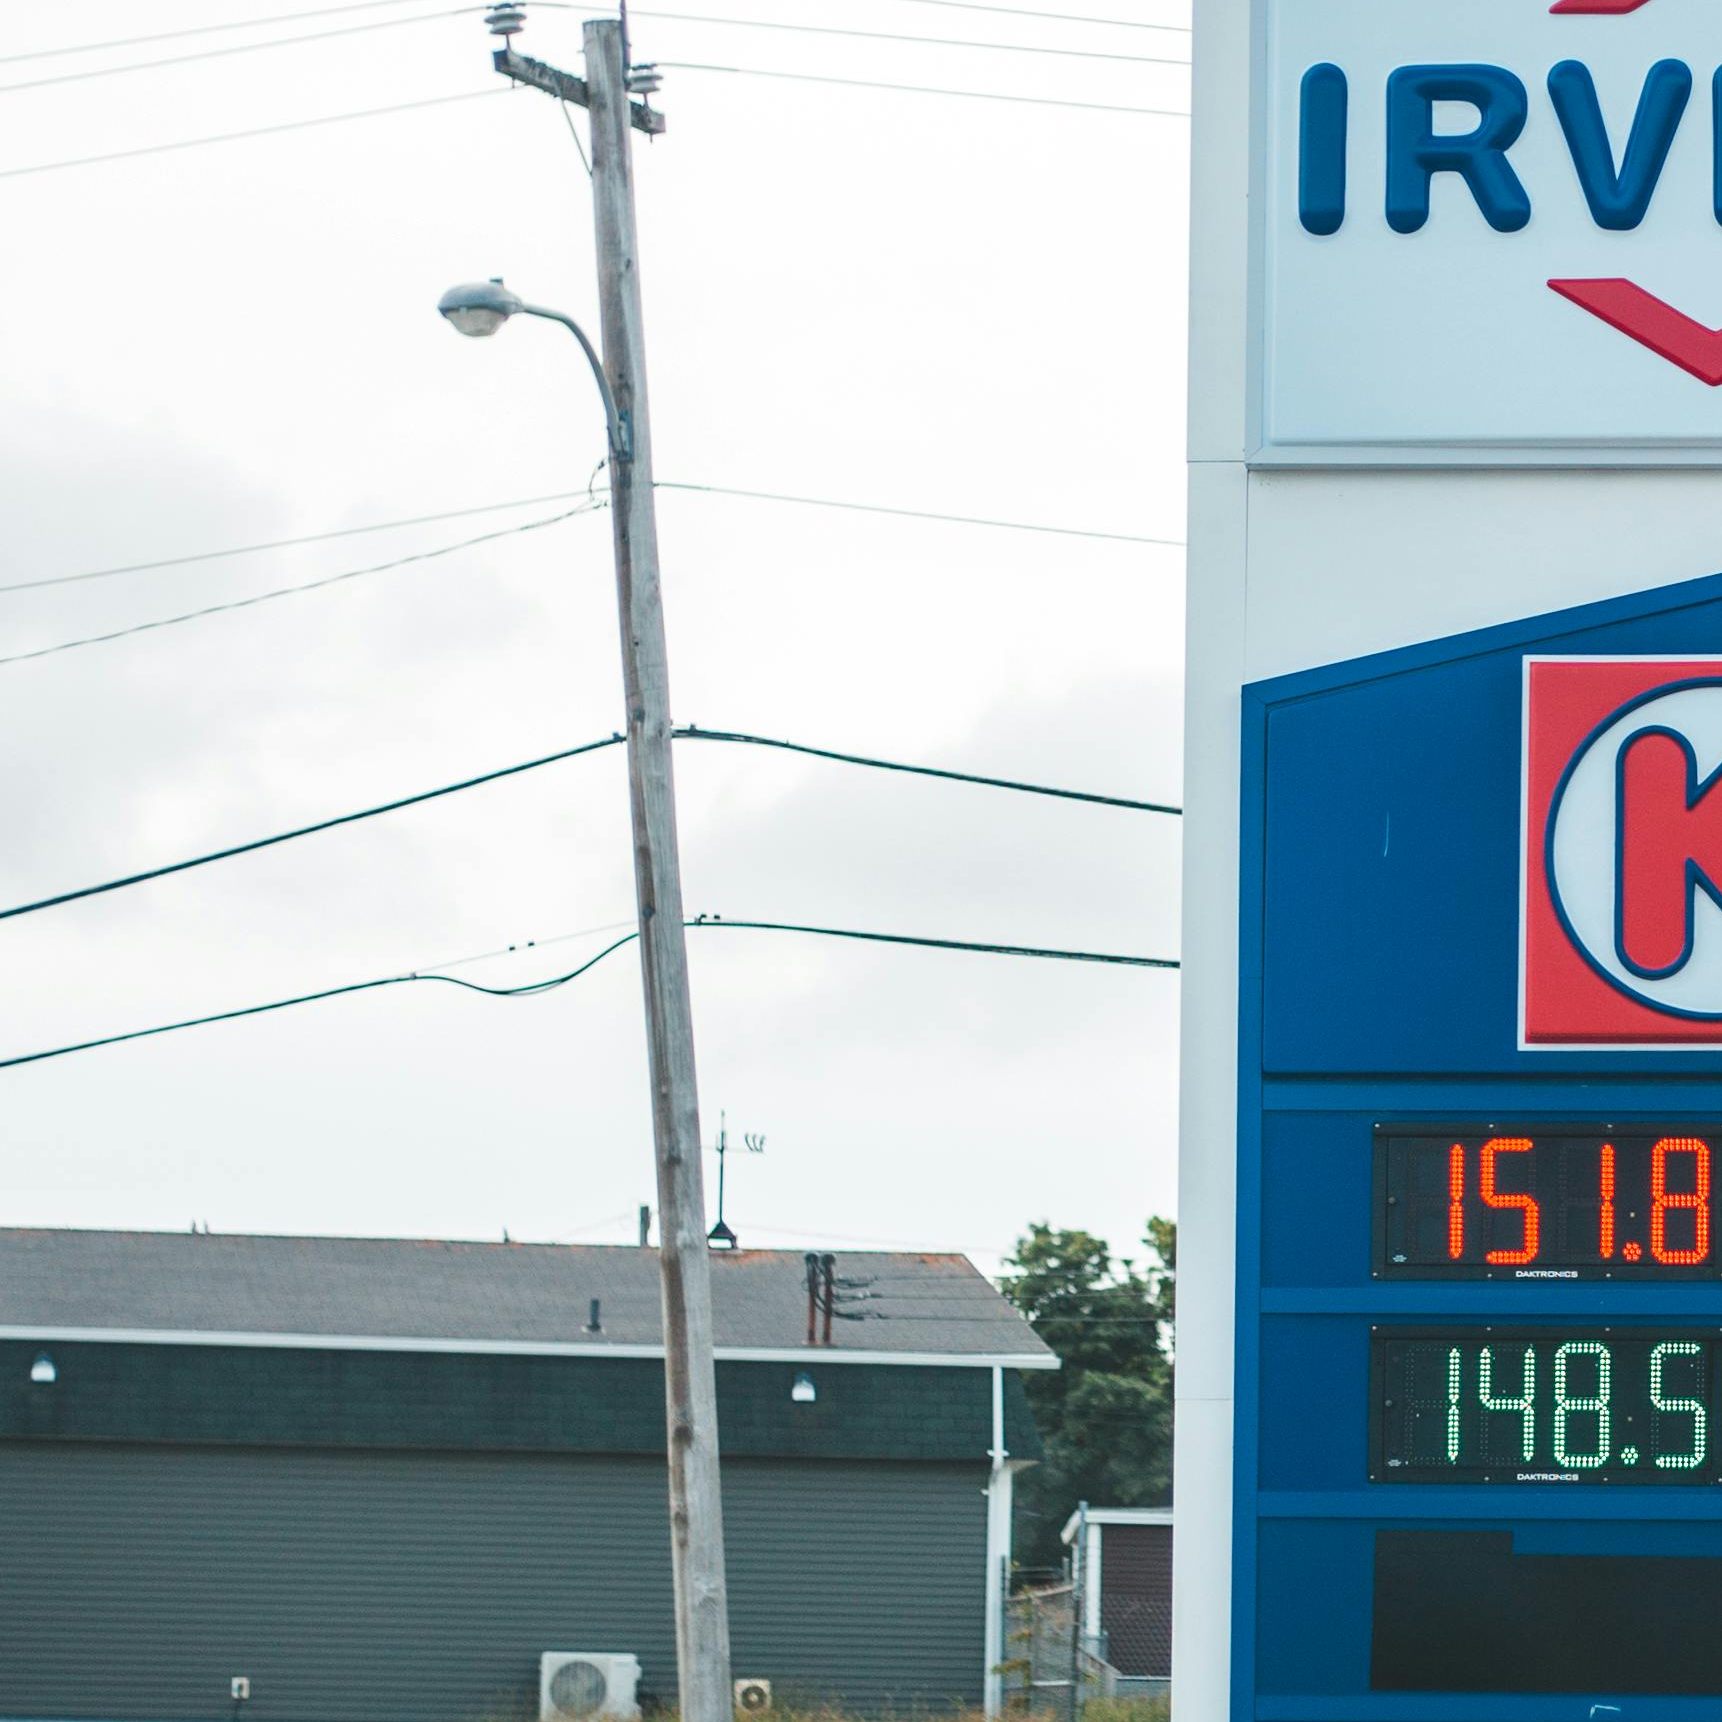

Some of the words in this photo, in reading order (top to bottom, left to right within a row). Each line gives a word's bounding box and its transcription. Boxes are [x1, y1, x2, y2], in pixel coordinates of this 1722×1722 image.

[1449, 1137, 1710, 1265] 151.8
[1515, 1269, 1578, 1278] DAKTRONICS
[1447, 1342, 1706, 1468] 148.5
[1516, 1472, 1579, 1481] DAKTRONICS
